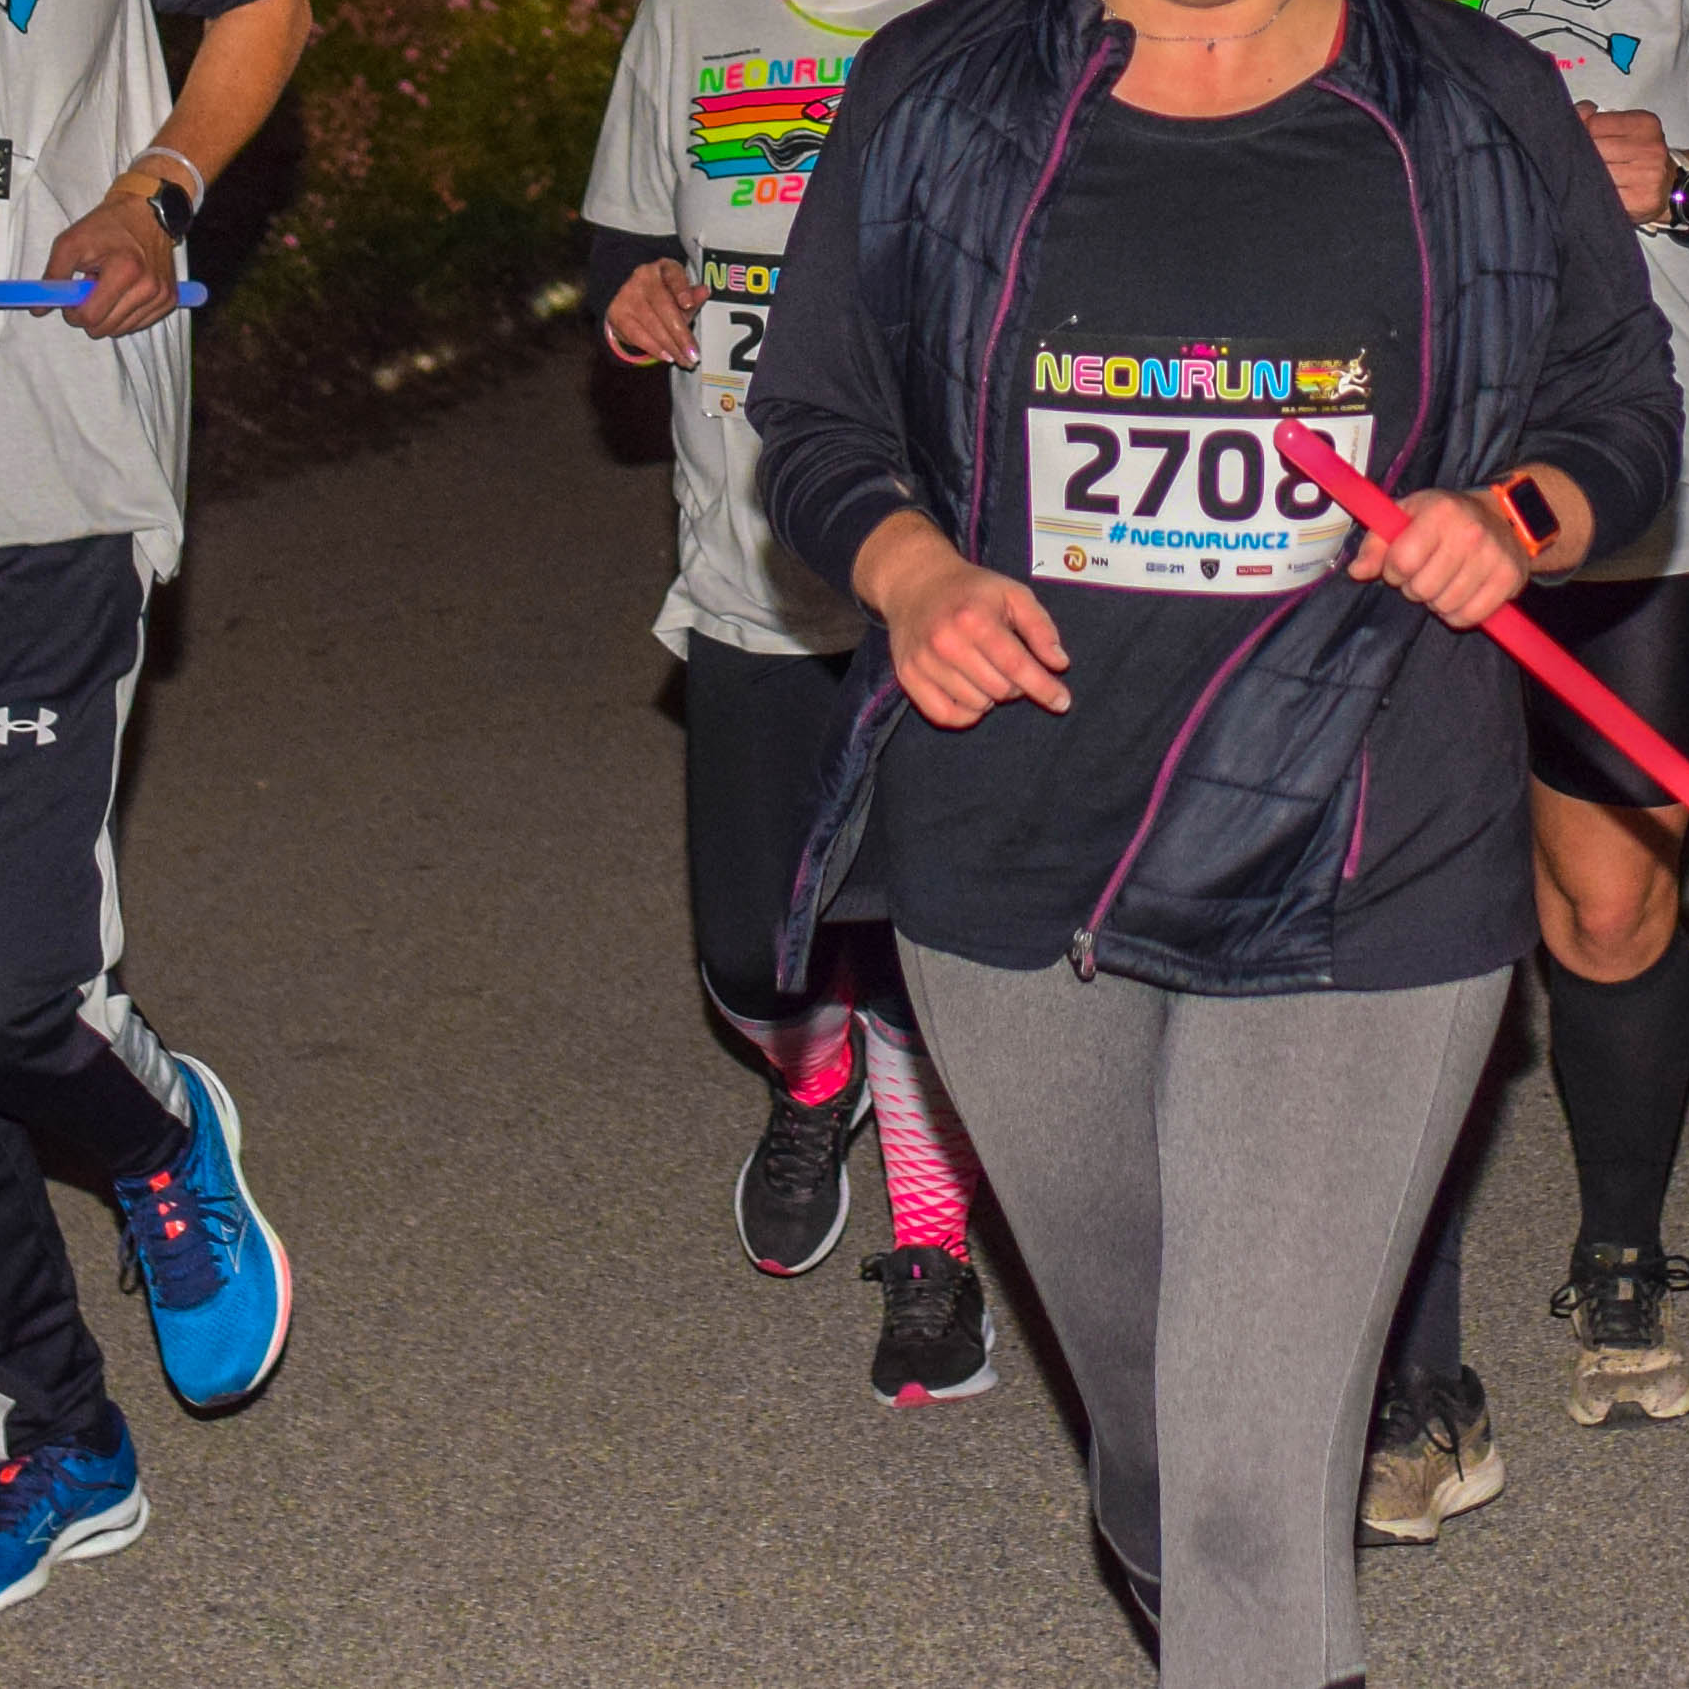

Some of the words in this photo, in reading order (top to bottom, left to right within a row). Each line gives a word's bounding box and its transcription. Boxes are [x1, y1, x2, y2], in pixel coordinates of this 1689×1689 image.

[730, 175, 805, 207] 202
[1035, 351, 1292, 401] NEONRUN
[1107, 521, 1291, 551] #NEONRUNCZ
[1091, 557, 1109, 567] NN
